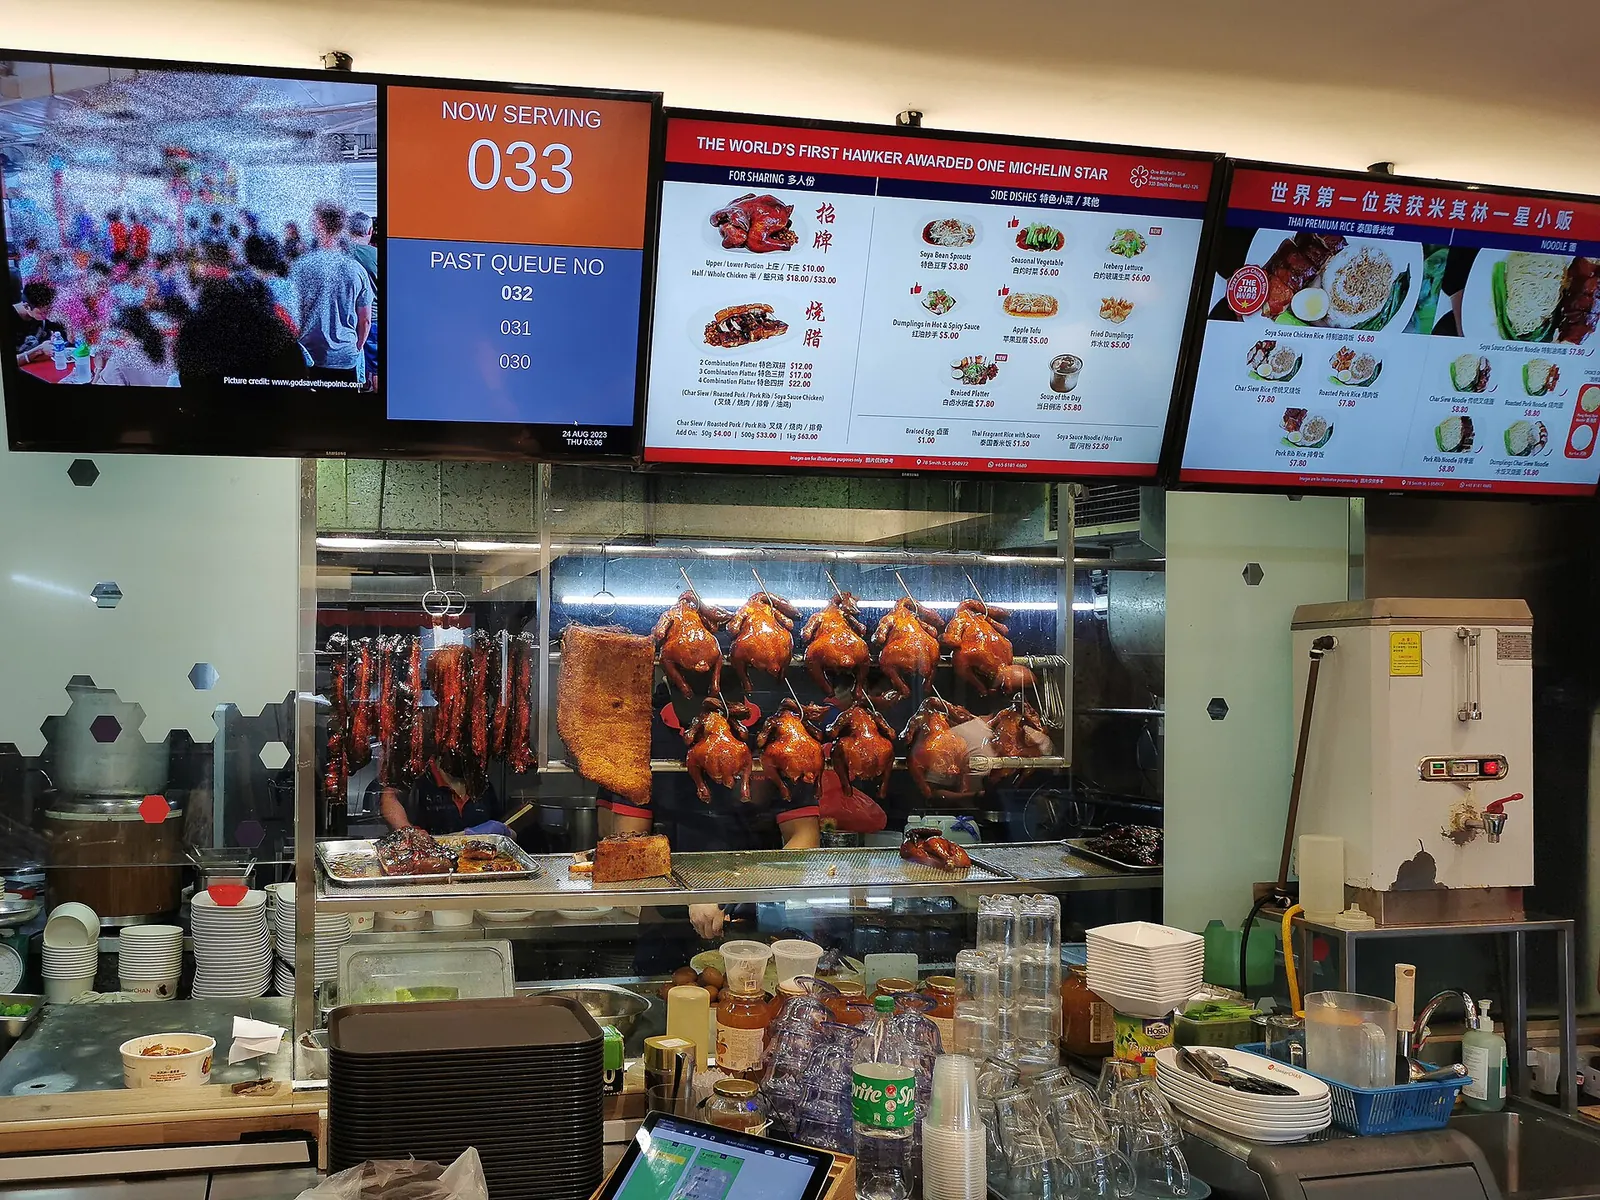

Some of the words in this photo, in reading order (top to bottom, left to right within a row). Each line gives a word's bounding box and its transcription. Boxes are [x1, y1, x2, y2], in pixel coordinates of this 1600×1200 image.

[442, 101, 497, 122] NOW
[503, 104, 601, 128] SERVING
[697, 136, 726, 151] THE
[799, 144, 839, 160] FIRST
[842, 148, 902, 165] HAWKER
[905, 153, 974, 170] AWARDED
[977, 158, 1006, 174] ONE
[1008, 161, 1071, 178] MICHELIN
[1073, 165, 1108, 181] STAR
[467, 138, 573, 194] 033
[728, 170, 745, 182] FOR
[746, 171, 784, 184] SHARING
[787, 174, 815, 187] 多人份
[990, 189, 1009, 201] SIDE
[1009, 191, 1037, 203] DISHES
[1039, 193, 1074, 206] 特色小菜
[1082, 196, 1100, 208] 其他
[812, 201, 836, 254] 招牌
[1288, 216, 1304, 228] THAI
[1304, 217, 1338, 231] PREMIUM
[1339, 220, 1355, 232] RICE
[1357, 223, 1394, 237] 泰国香米饭
[1541, 239, 1568, 250] NOODLE
[920, 250, 934, 260] Soya
[934, 251, 949, 259] Bean
[949, 252, 972, 261] Sprouts
[430, 251, 485, 271] PAST
[491, 254, 567, 276] QUEUE
[573, 257, 604, 276] NO
[705, 259, 723, 269] Upper
[726, 261, 744, 269] Lower
[744, 261, 764, 270] Portion
[802, 263, 825, 273] $10.00
[948, 262, 969, 271] $3.80
[1010, 256, 1036, 265] Seasonal
[1036, 257, 1064, 267] Vegetable
[1039, 267, 1060, 277] $6.00
[1103, 262, 1124, 272] Iceberg
[1124, 263, 1144, 272] Lettuce
[691, 269, 704, 277] Half
[707, 270, 726, 278] Whole
[726, 270, 748, 279] Chicken
[786, 273, 809, 283] $18.00
[813, 275, 837, 285] $33.00
[1131, 273, 1151, 283] $6.00
[1242, 278, 1257, 286] THE
[501, 285, 533, 301] 032
[1238, 285, 1257, 294] STAR
[500, 319, 531, 336] 031
[802, 300, 826, 349] 烧腊
[892, 319, 925, 329] Dumplings
[925, 320, 931, 328] in
[942, 321, 948, 329] &
[948, 322, 963, 331] Spicy
[963, 322, 980, 331] Sauce
[939, 331, 959, 340] $5.00
[1012, 326, 1029, 335] Apple
[1029, 326, 1041, 334] Tofu
[1090, 330, 1104, 338] Fried
[1104, 331, 1134, 341] Dumplings
[1028, 336, 1049, 345] $5.00
[1265, 329, 1277, 338] Soya
[1277, 330, 1293, 338] Sauce
[1293, 331, 1313, 339] Chicken
[1313, 331, 1324, 339] Rice
[1357, 334, 1375, 343] $6.80
[1110, 341, 1130, 350] $5.00
[1568, 348, 1585, 356] $7.80
[499, 353, 531, 370] 030
[699, 359, 704, 367] 2
[704, 359, 739, 368] Combination
[790, 362, 813, 371] $12.00
[703, 368, 738, 377] Combination
[739, 369, 757, 377] Platter
[789, 371, 812, 379] $17.00
[223, 376, 247, 385] Picture
[248, 377, 270, 386] credit:
[271, 378, 364, 389] www.godsavethepoints.com
[703, 377, 738, 386] Combination
[738, 378, 756, 386] Platter
[788, 380, 811, 388] $22.00
[950, 389, 971, 397] Braised
[972, 390, 990, 398] Platter
[1040, 393, 1054, 401] Soup
[1070, 394, 1082, 402] Day
[1256, 394, 1276, 403] $7.80
[974, 399, 995, 408] $7.80
[1063, 403, 1082, 411] $5.80
[1337, 399, 1356, 408] $7.80
[1451, 405, 1469, 413] $8.80
[1523, 409, 1541, 417] $8.80
[562, 430, 571, 438] 24
[572, 430, 589, 438] AUG
[590, 431, 608, 439] 2023
[675, 428, 688, 437] Add
[688, 429, 698, 437] On:
[701, 429, 712, 439] 50g
[713, 429, 732, 438] $4.00
[740, 431, 755, 440] 500g
[756, 431, 777, 440] $33.00
[786, 432, 797, 441] 1kg
[797, 433, 818, 441] $63.00
[905, 427, 925, 435] Braised
[925, 428, 935, 436] Egg
[982, 430, 1003, 438] Fragrant
[566, 438, 582, 446] THU
[917, 436, 936, 444] $1.00
[1091, 442, 1109, 450] $2.50
[1274, 449, 1286, 457] Pork
[1295, 450, 1307, 458] Rice
[1289, 459, 1307, 467] $7.80
[1438, 465, 1455, 473] $8.80
[1522, 468, 1540, 476] $8.80
[1146, 1027, 1169, 1036] HOSEN
